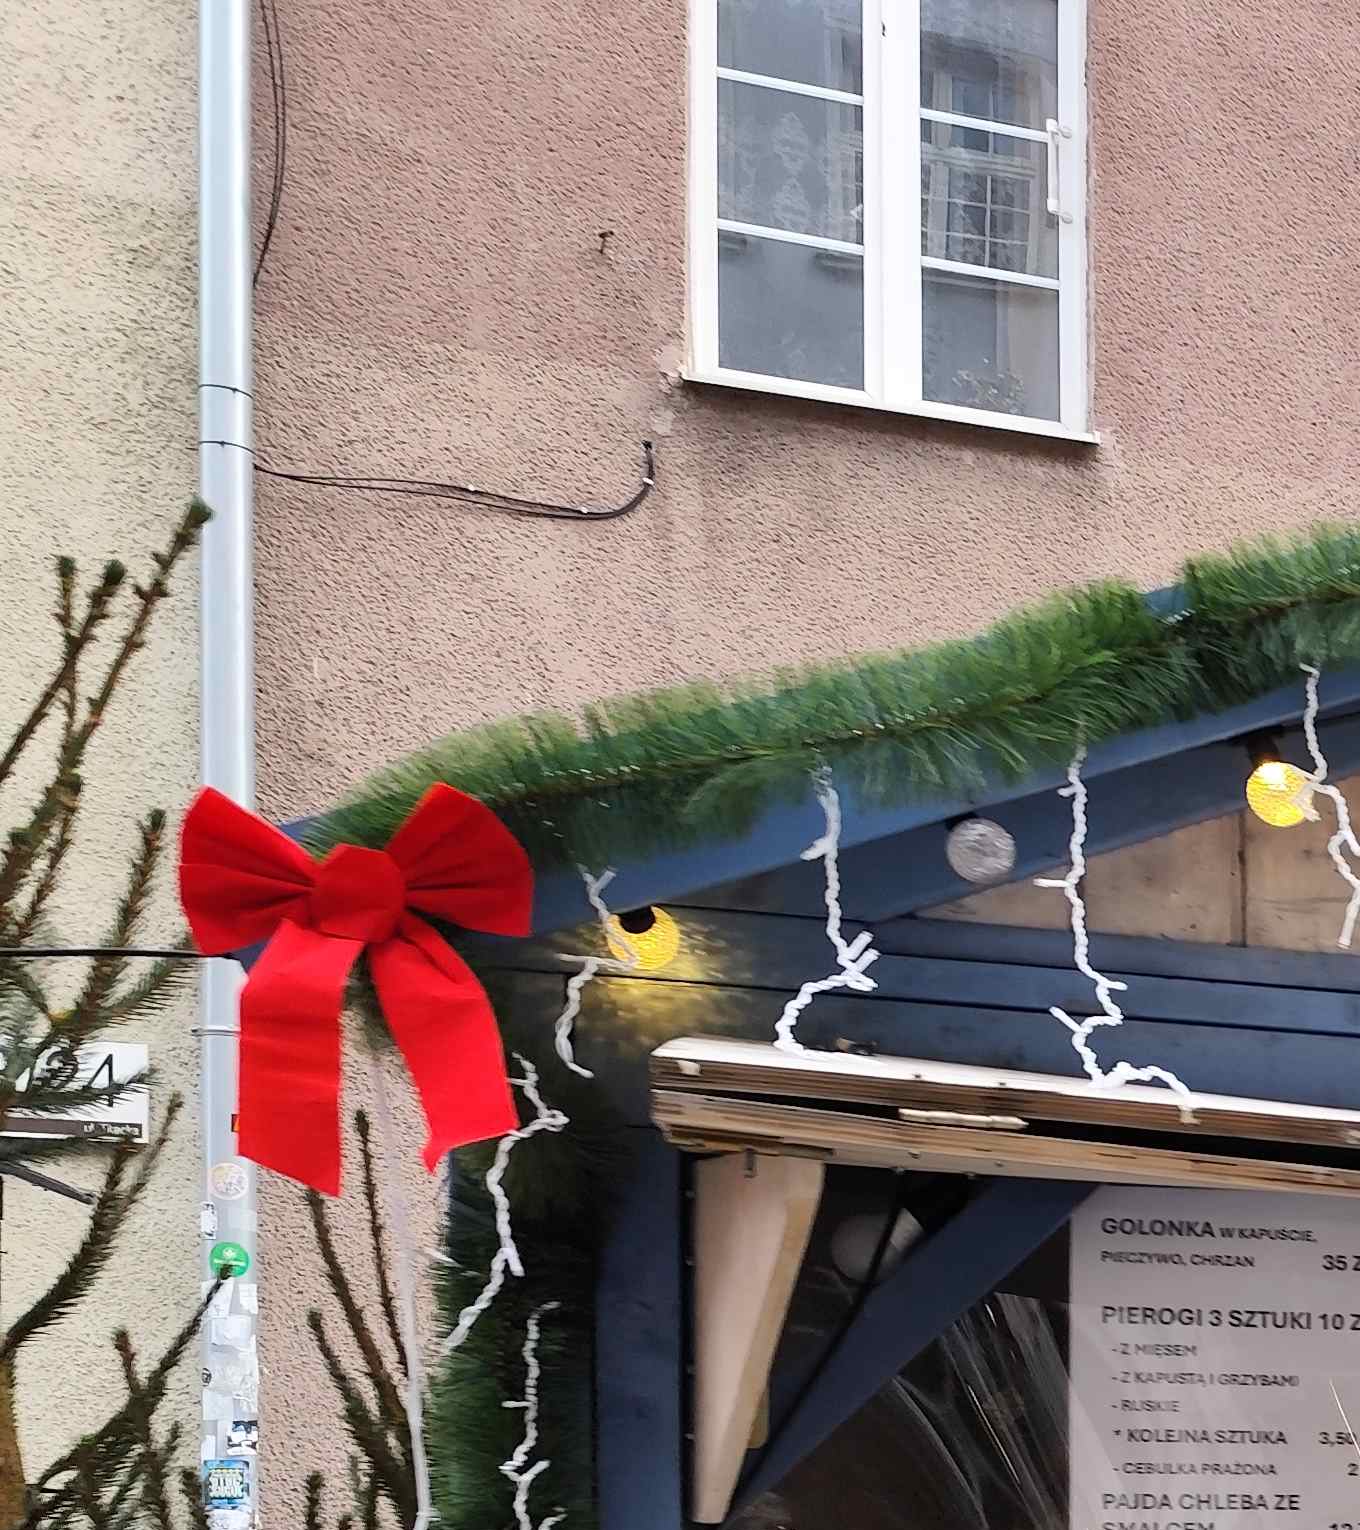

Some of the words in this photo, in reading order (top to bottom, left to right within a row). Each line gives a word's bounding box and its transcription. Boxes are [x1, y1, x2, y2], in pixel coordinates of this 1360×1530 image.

[1101, 1218, 1216, 1239] GOLONKA
[1219, 1227, 1236, 1239] W
[1190, 1253, 1255, 1268] CHRZAN
[1322, 1254, 1348, 1271] 35
[1102, 1305, 1203, 1327] PIEROGI
[1208, 1308, 1223, 1327] 3
[1228, 1310, 1312, 1330] SZTUKI
[1318, 1313, 1344, 1331] 10
[1218, 1374, 1300, 1387] GRZYBAMI
[1127, 1429, 1211, 1444] KOLEJNA
[1215, 1430, 1288, 1445] SZTUKA
[1122, 1462, 1196, 1475] CEBULKA
[1347, 1463, 1358, 1476] 2
[1102, 1493, 1173, 1511] PAJDA
[1179, 1493, 1270, 1511] CHLEBA
[1274, 1494, 1301, 1511] ZE
